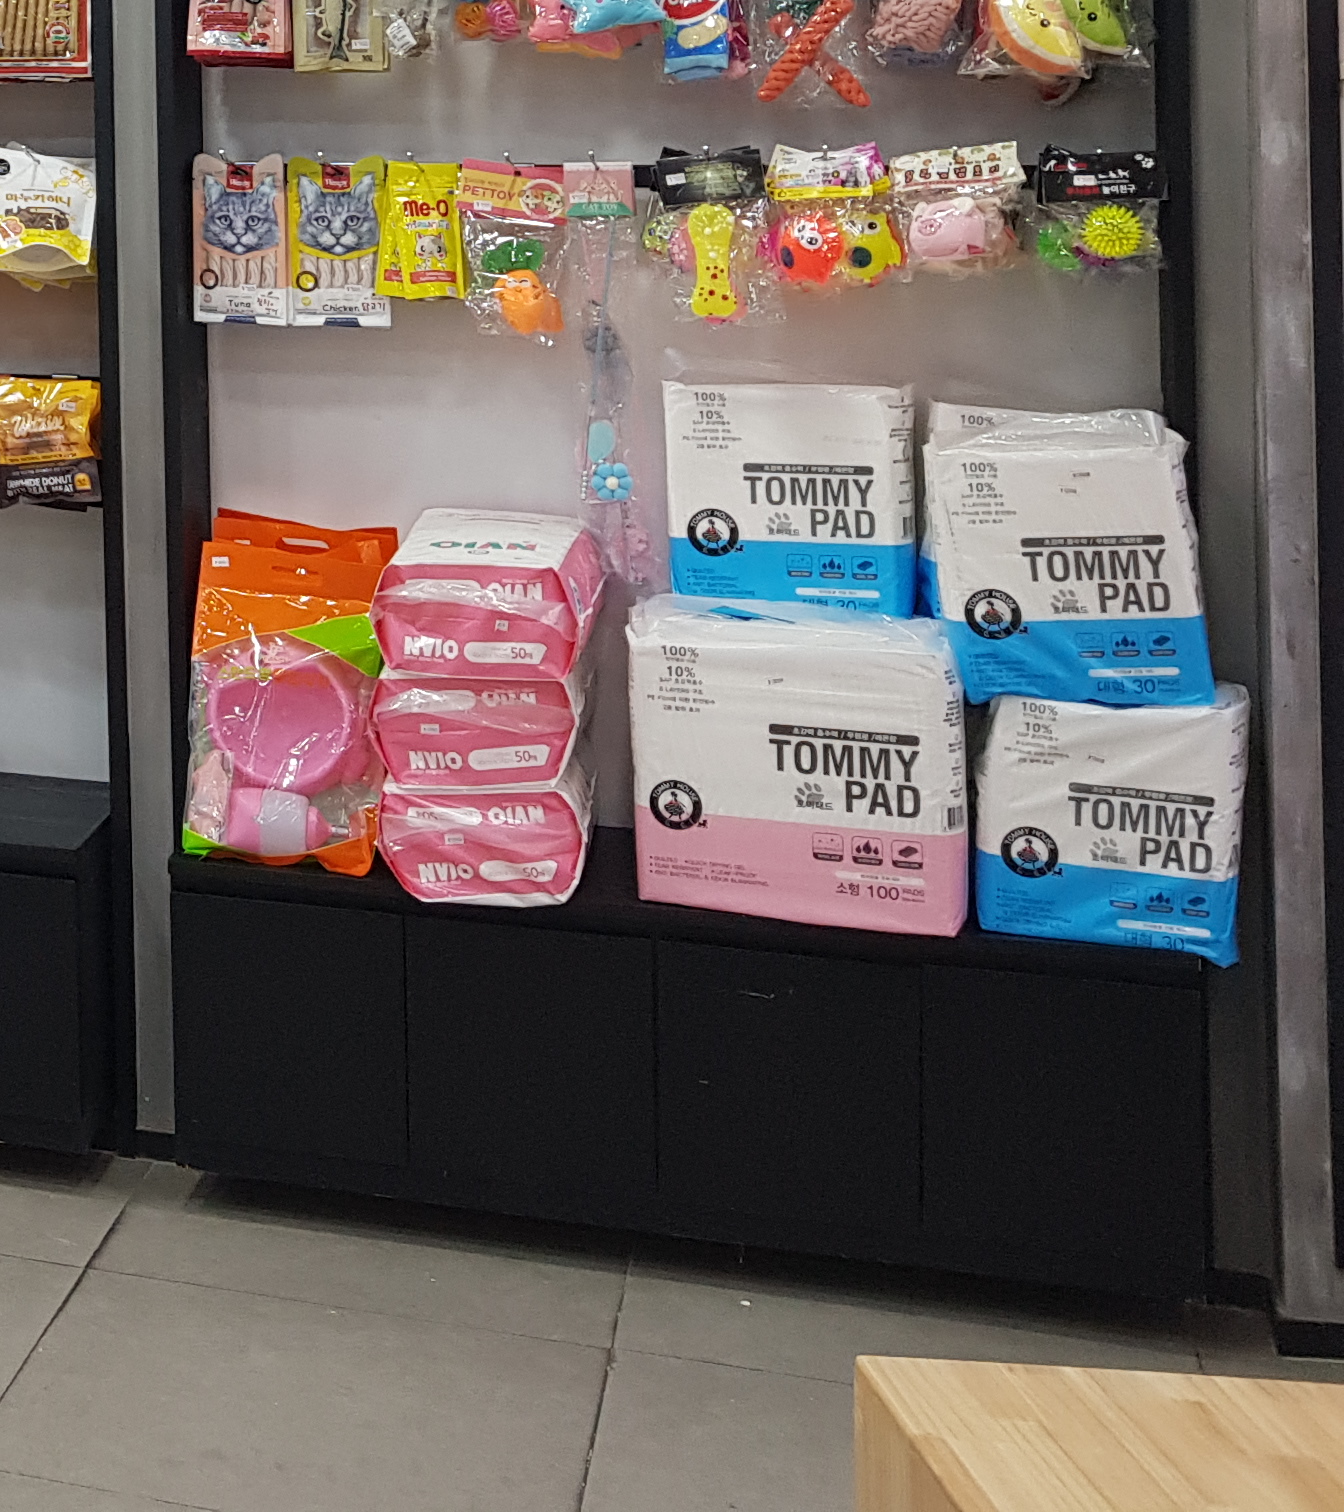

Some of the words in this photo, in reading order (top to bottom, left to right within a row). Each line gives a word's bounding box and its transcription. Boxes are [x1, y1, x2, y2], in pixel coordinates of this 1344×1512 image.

[462, 184, 517, 202] PETTOY
[228, 299, 252, 308] Tuna
[322, 302, 361, 313] Chicken
[693, 391, 727, 402] 100%
[699, 410, 725, 420] 10%
[960, 413, 996, 426] 100%
[961, 462, 998, 474] 100%
[42, 473, 74, 486] DONUT
[967, 482, 996, 493] 10%
[742, 475, 875, 507] TOMMY
[809, 508, 876, 539] PAD
[1021, 548, 1167, 582] TOMMY
[1096, 582, 1171, 614] PAD
[402, 636, 460, 660] NVIO
[661, 645, 700, 659] 100%
[666, 665, 696, 678] 10%
[1133, 678, 1157, 695] 30
[1021, 701, 1059, 717] 100%
[1024, 721, 1053, 735] 10%
[408, 750, 463, 771] NVIO
[768, 737, 920, 783] TOMMY
[844, 779, 922, 819] PAD
[1068, 795, 1215, 841] TOMMY
[1138, 836, 1213, 875] PAD
[418, 861, 474, 884] NVIO
[836, 881, 860, 897] 소형
[867, 884, 900, 900] 100
[1162, 937, 1185, 952] 30
